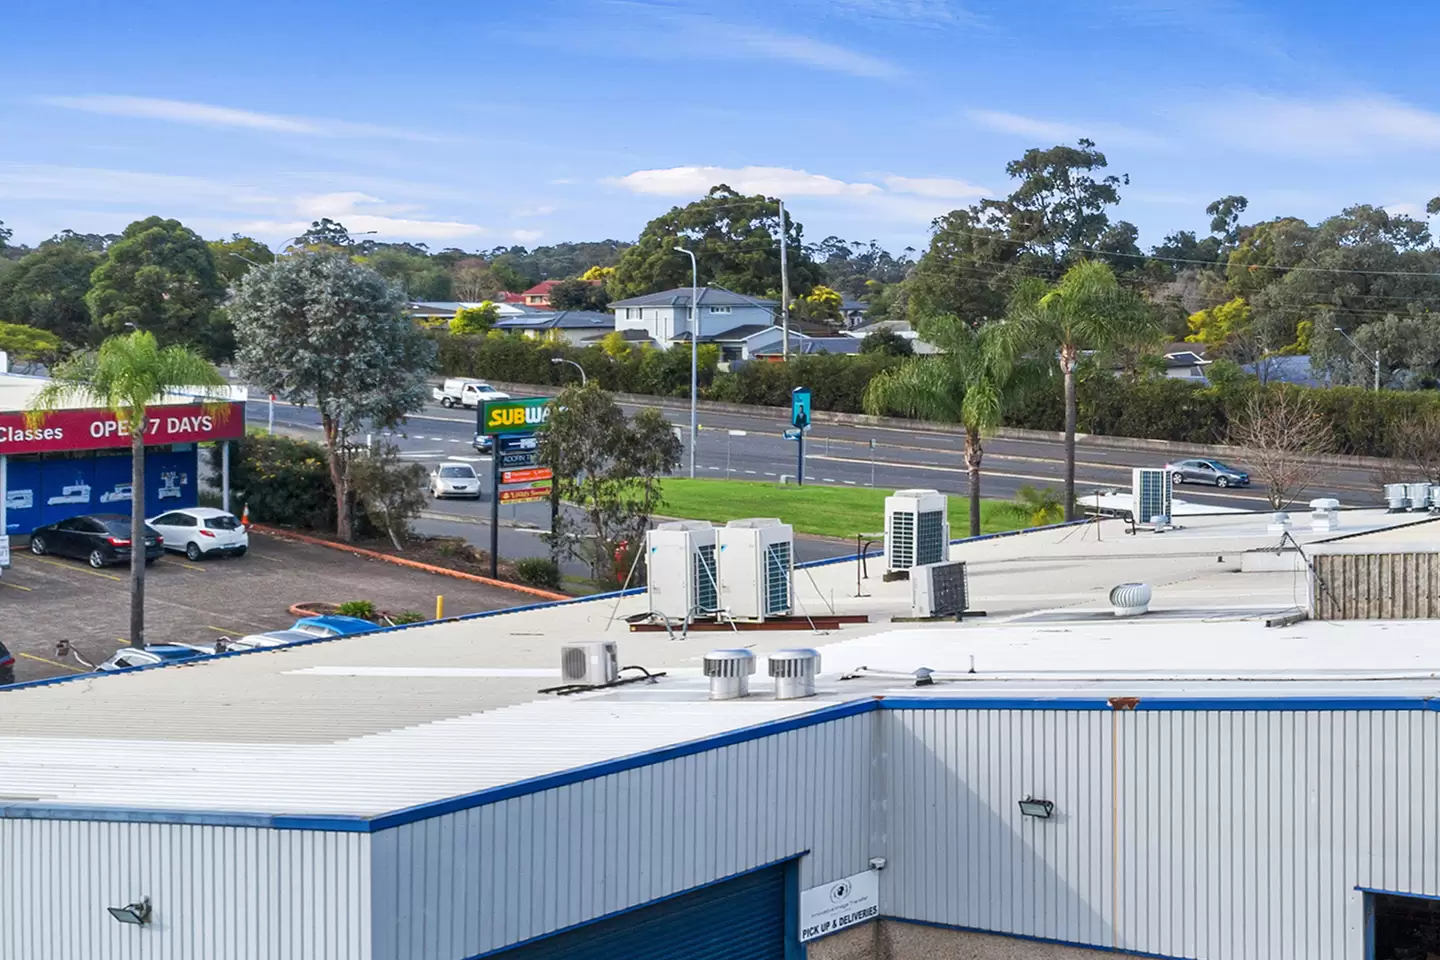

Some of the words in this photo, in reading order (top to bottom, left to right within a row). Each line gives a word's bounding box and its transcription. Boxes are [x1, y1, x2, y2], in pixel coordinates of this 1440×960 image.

[90, 419, 146, 438] OPE
[149, 418, 161, 434] 7
[167, 415, 213, 433] DAYS
[488, 406, 568, 427] SUBWA
[802, 925, 820, 939] PICK
[820, 921, 831, 932] UP
[832, 919, 838, 929] &
[838, 905, 878, 927] DELIVERIES
